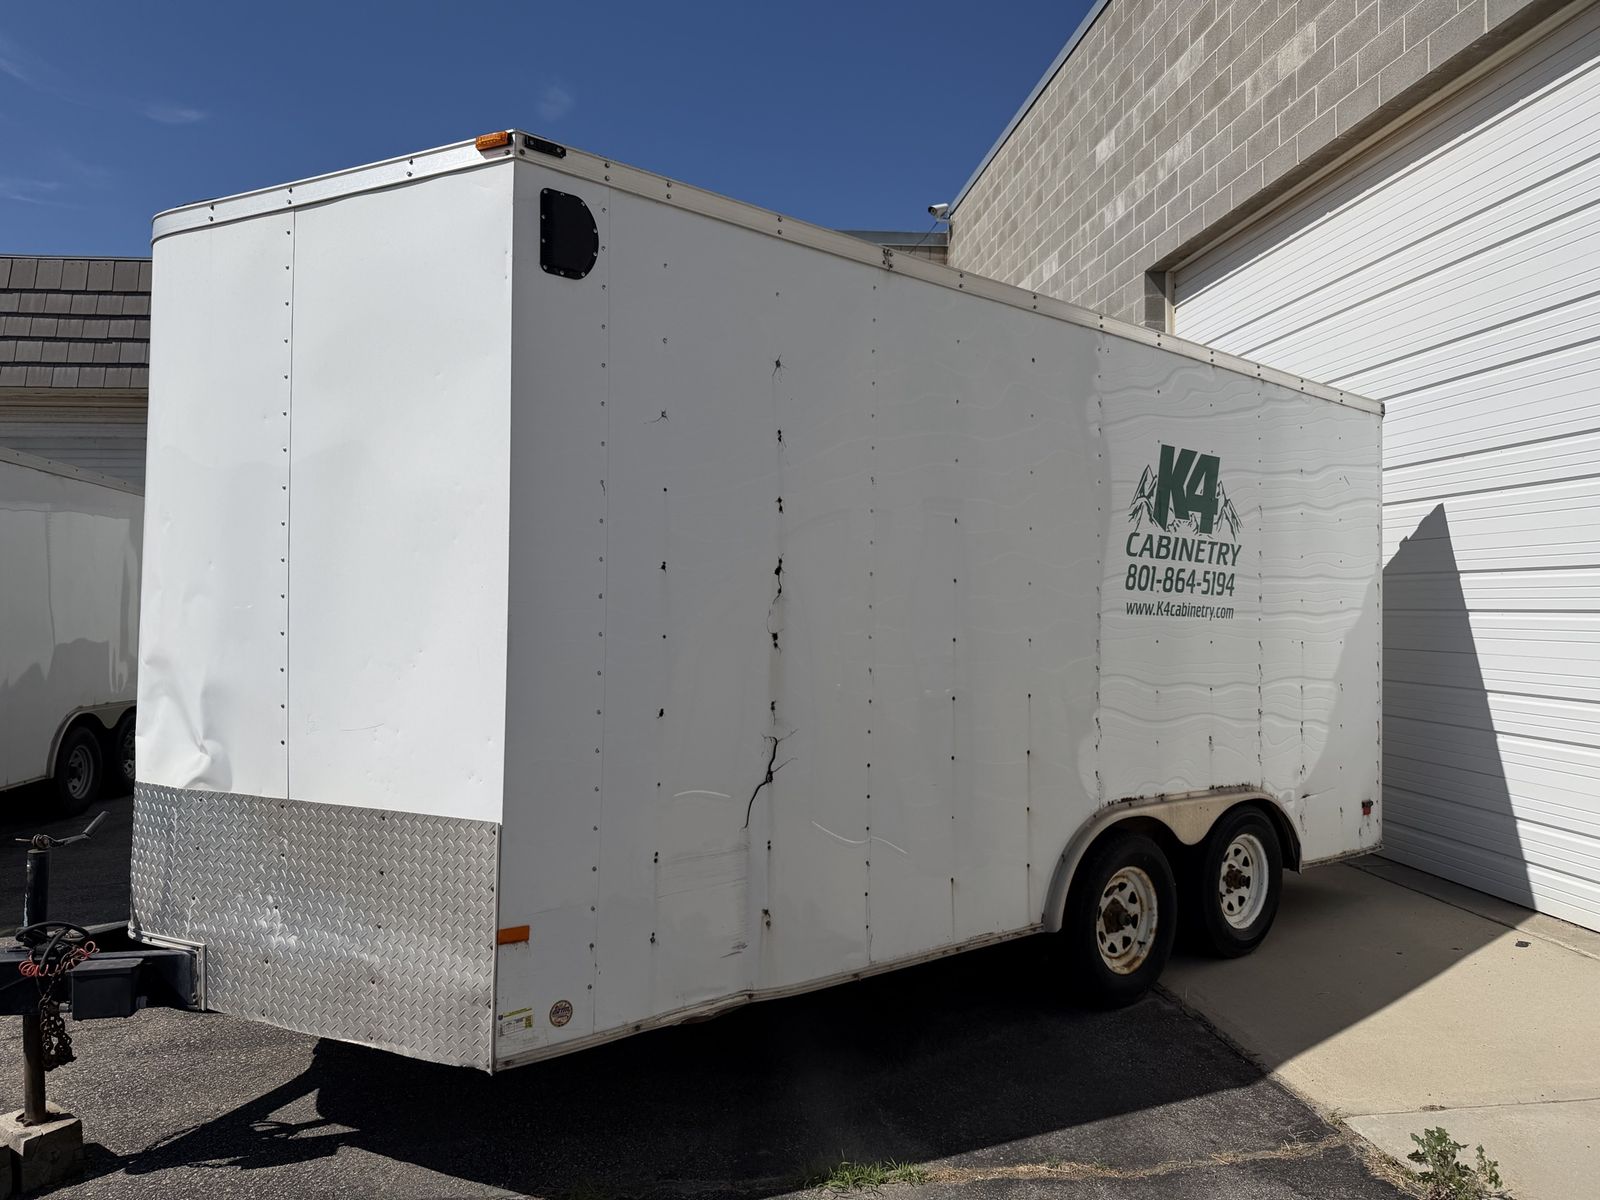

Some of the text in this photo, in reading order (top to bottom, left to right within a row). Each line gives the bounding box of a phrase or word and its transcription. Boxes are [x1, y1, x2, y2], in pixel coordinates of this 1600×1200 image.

[1153, 444, 1220, 534] K4
[1126, 532, 1242, 567] CABINETRY
[1125, 564, 1235, 596] 801-864-5194
[1126, 601, 1234, 621] www.K4cabinetry.com
